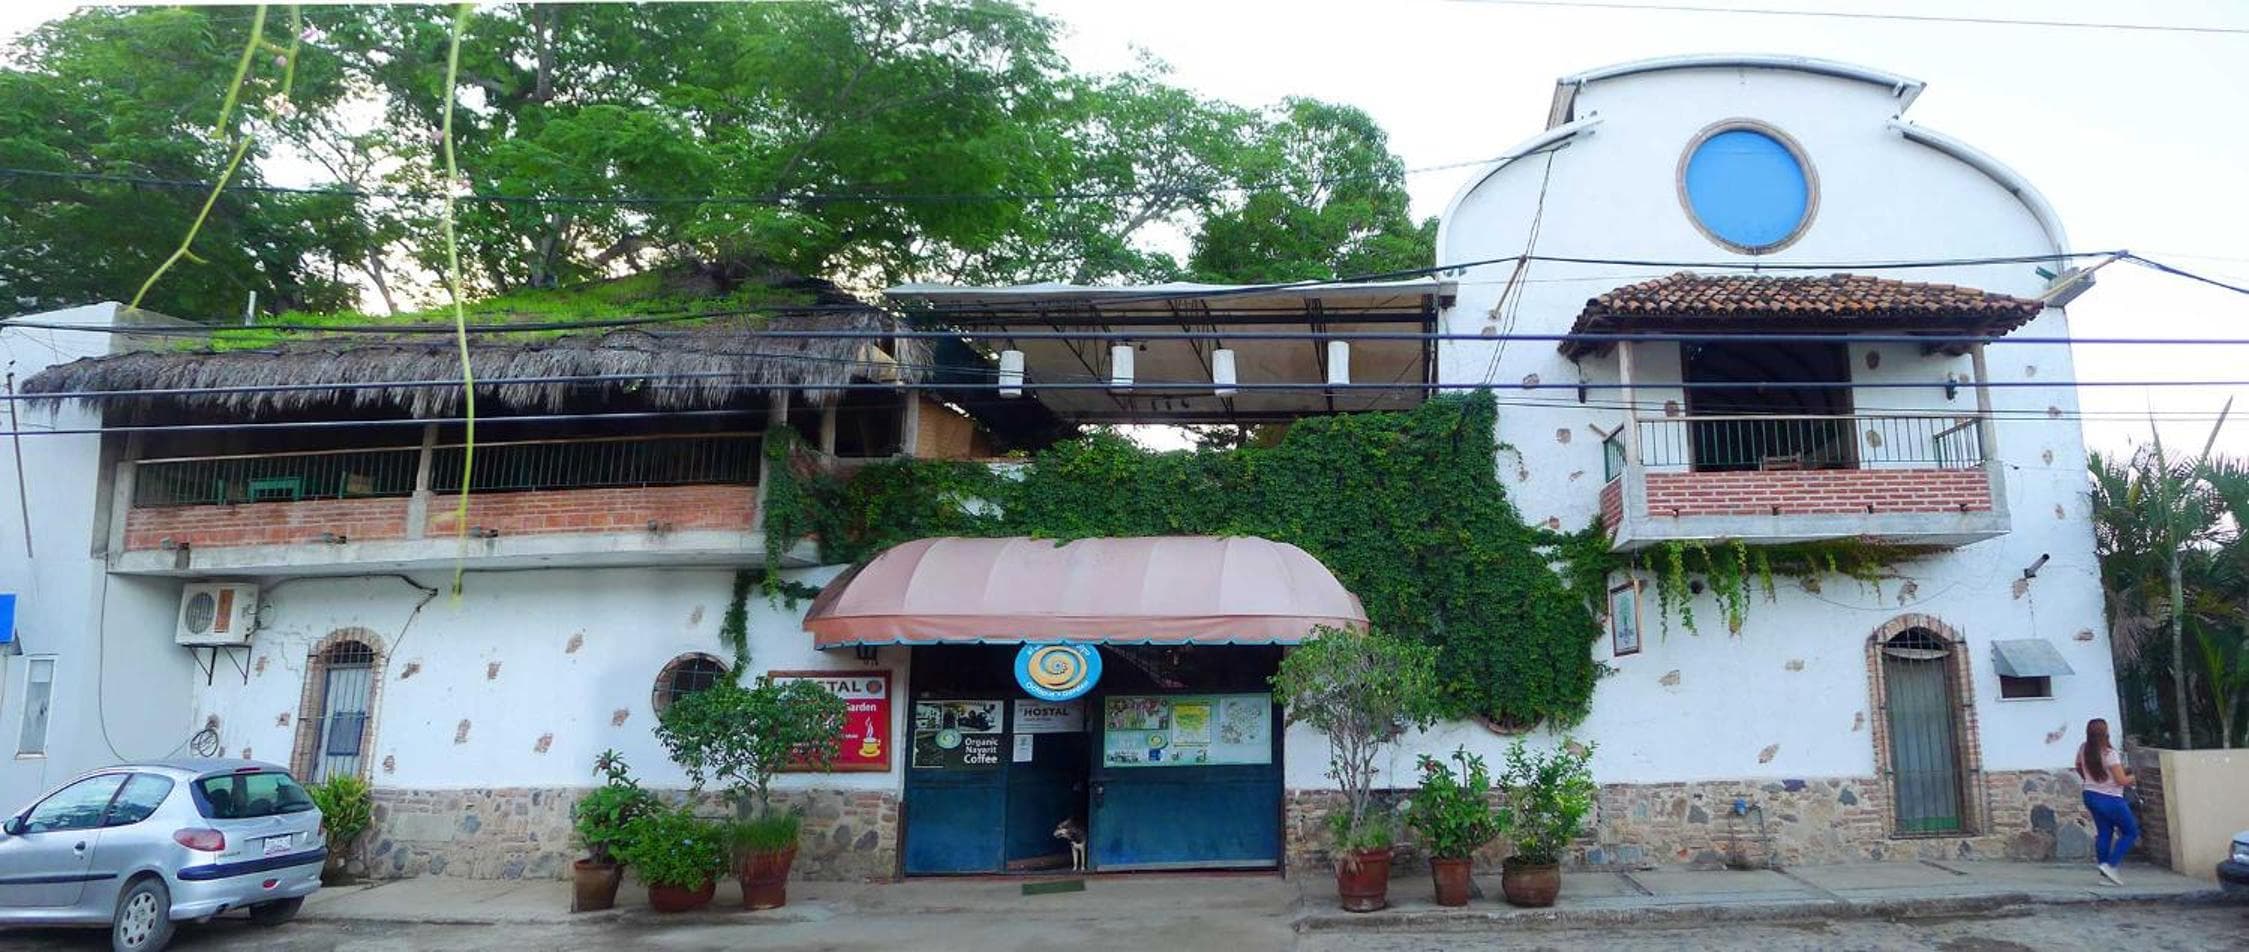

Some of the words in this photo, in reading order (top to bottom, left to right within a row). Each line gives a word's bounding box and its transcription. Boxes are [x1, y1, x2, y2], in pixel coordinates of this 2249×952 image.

[1023, 707, 1069, 716] HOSTAL
[964, 737, 998, 747] Organic
[965, 746, 996, 755] Nayarit
[963, 754, 998, 764] Coffee
